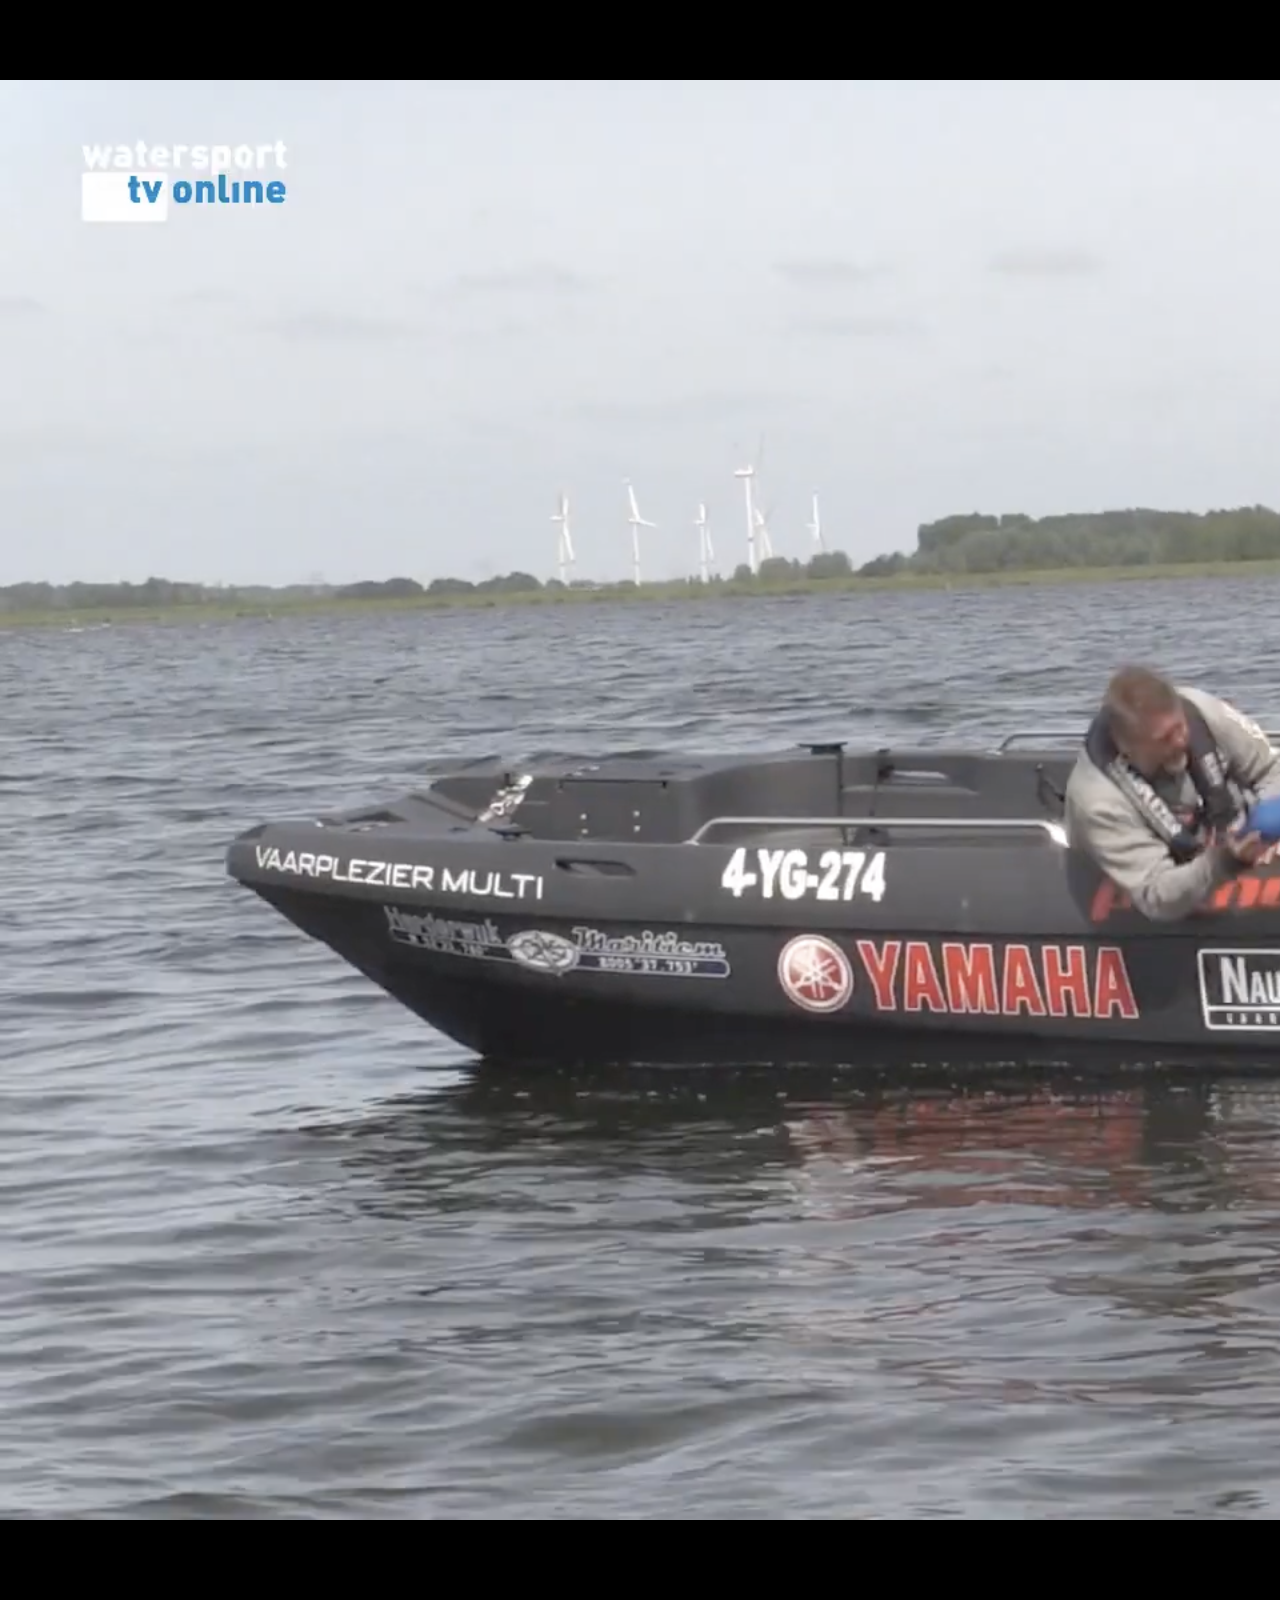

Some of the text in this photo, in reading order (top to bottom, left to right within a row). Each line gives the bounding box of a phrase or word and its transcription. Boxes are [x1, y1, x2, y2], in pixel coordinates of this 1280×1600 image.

[256, 845, 544, 900] VAARPLEZIER MULTI
[721, 847, 887, 902] 4-YG-274
[856, 939, 1140, 1019] YAMAHA
